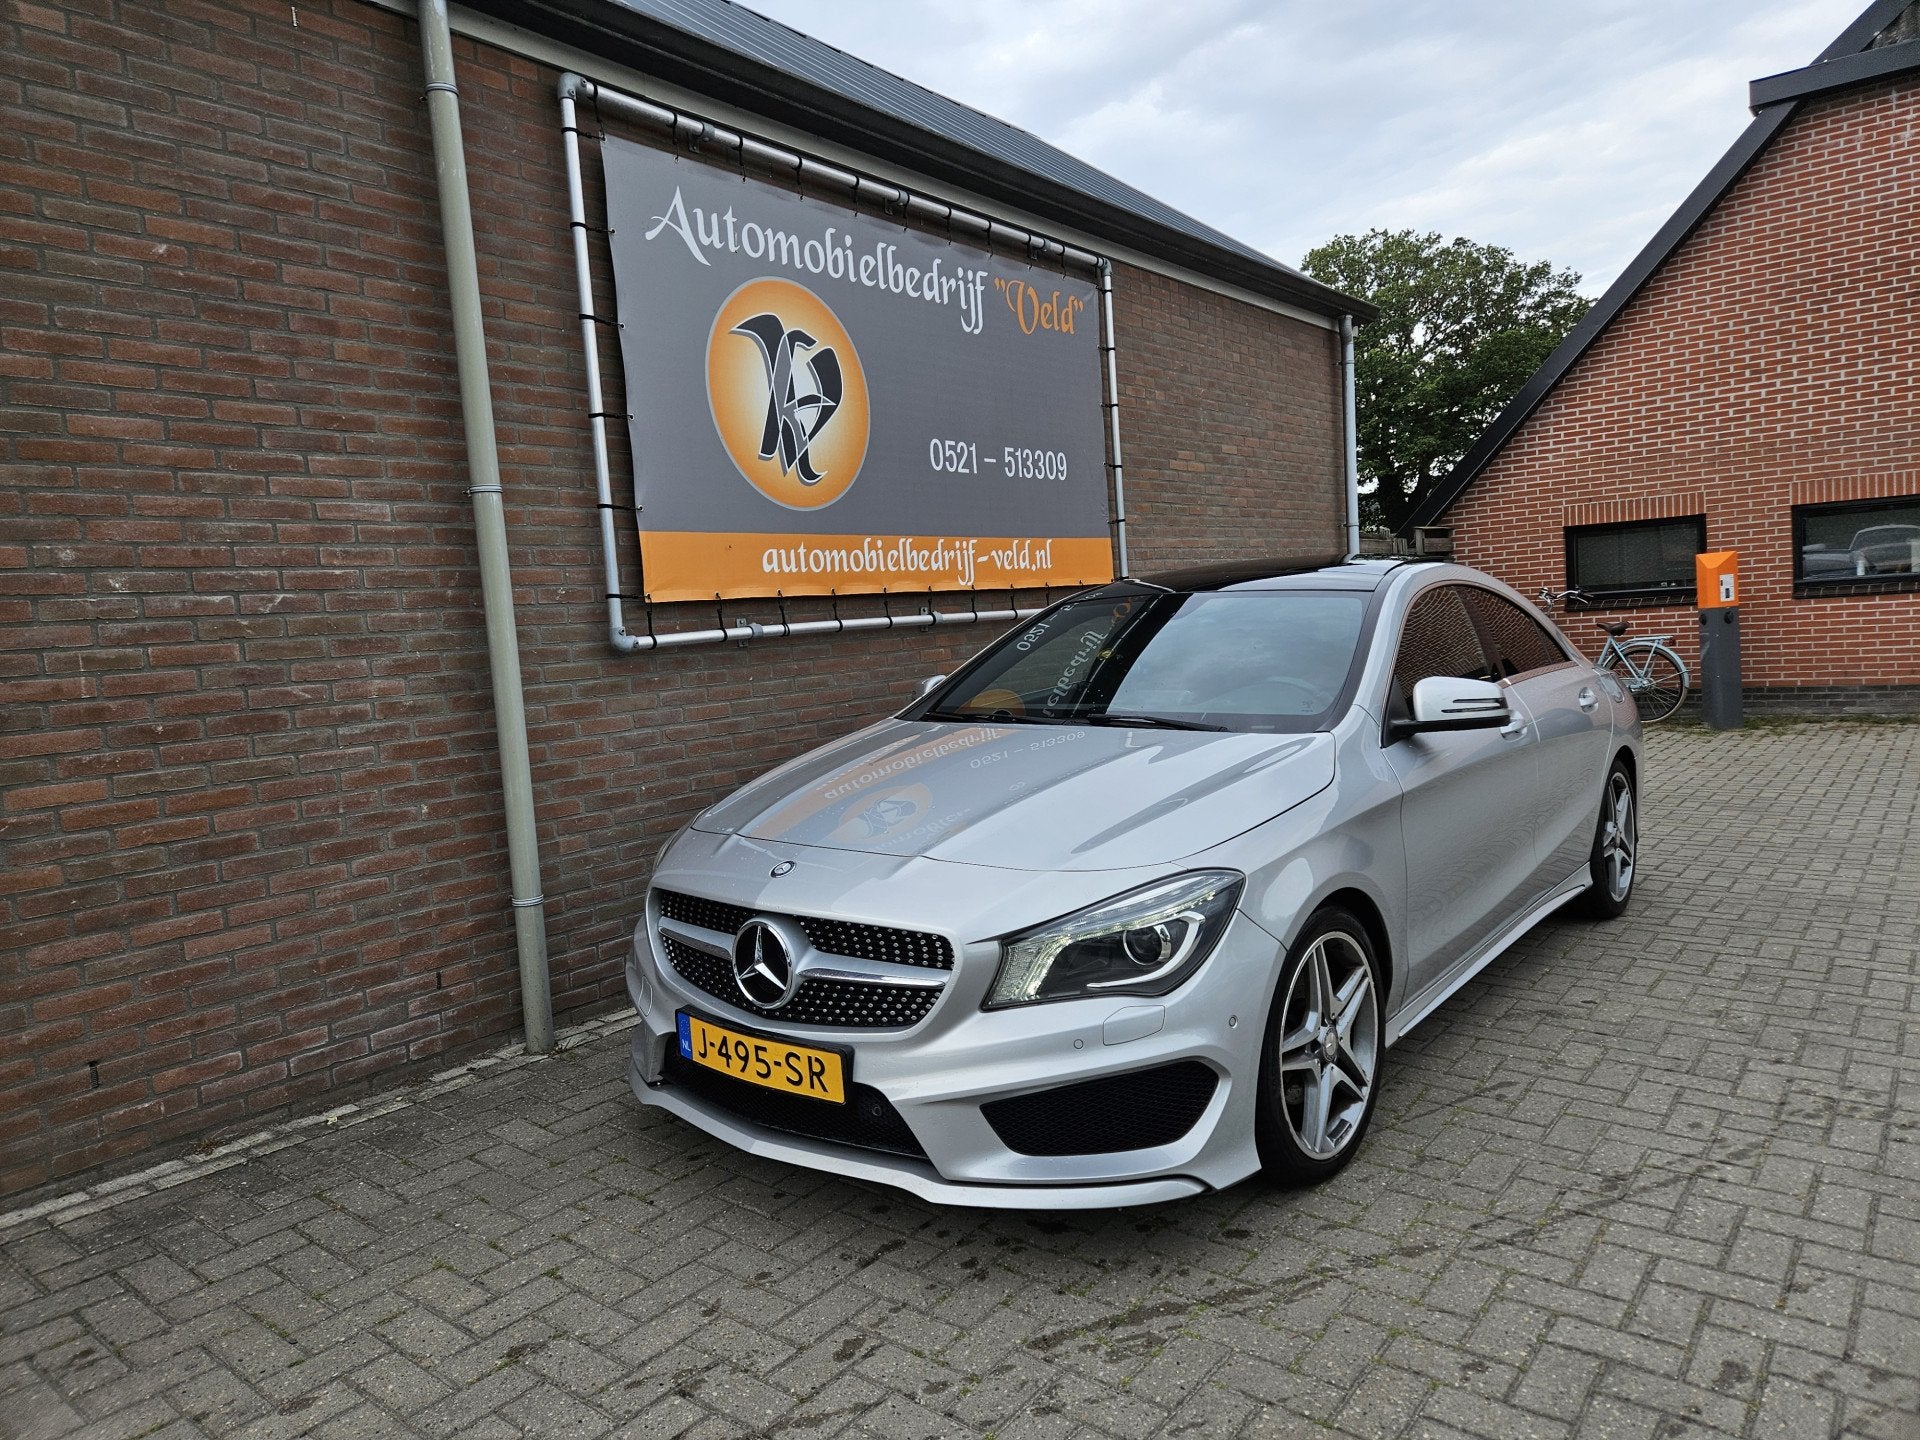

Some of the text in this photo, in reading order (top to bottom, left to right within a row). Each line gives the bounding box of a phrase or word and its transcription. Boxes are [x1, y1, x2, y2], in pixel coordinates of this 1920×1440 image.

[645, 185, 988, 335] Automobielbedrijf
[929, 438, 978, 474] 0521
[1004, 446, 1067, 481] 513309
[762, 537, 1053, 586] automobielbedrijf-veld.nl
[681, 1039, 692, 1052] NL
[698, 1027, 829, 1093] J-495-SR
